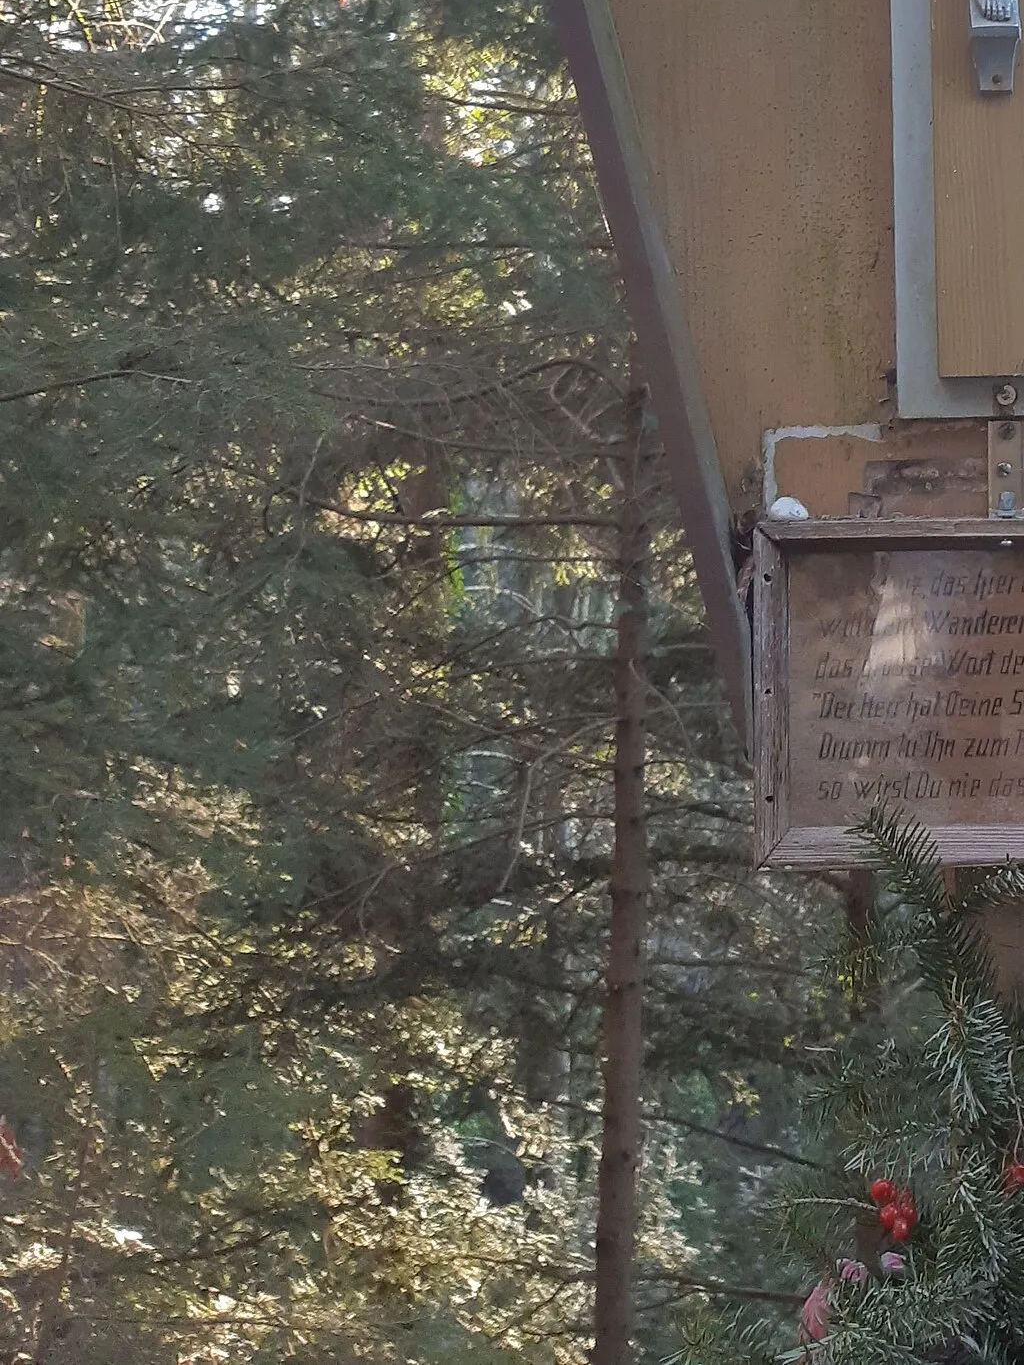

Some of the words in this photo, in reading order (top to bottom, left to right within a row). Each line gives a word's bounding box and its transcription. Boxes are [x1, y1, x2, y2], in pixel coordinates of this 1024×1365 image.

[929, 570, 967, 597] das
[973, 568, 1015, 601] hier
[815, 652, 852, 680] das
[940, 649, 996, 676] Wort
[859, 692, 903, 719] Herr
[906, 690, 941, 723] hat
[945, 690, 1003, 717] Deine
[963, 737, 1010, 759] zum
[818, 781, 844, 800] so
[854, 771, 911, 800] wirst
[915, 772, 943, 799] Du
[949, 772, 981, 798] nie
